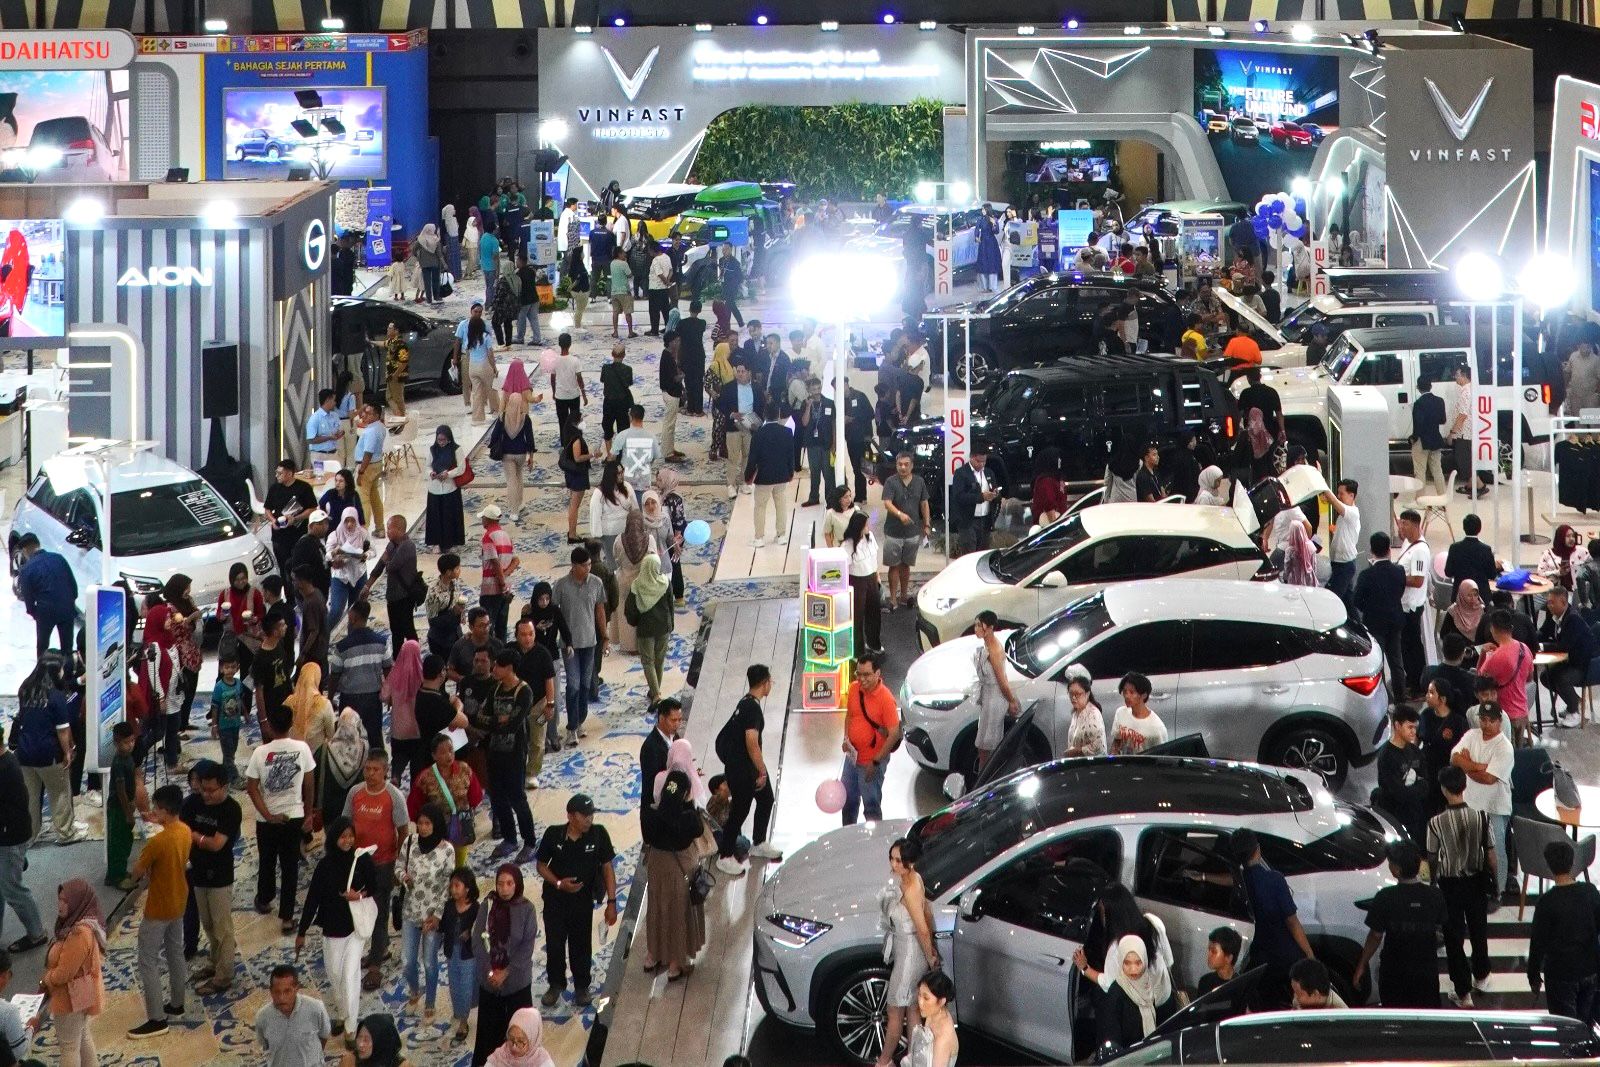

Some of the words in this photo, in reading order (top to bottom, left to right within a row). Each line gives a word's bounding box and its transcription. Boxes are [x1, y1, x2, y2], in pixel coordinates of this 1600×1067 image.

[1, 41, 110, 60] DAIHATSU
[233, 61, 274, 71] BAHAGIA
[304, 60, 347, 71] PERTAMA
[1254, 65, 1293, 75] VINFAST
[1244, 87, 1295, 104] FUTURE
[578, 108, 685, 122] VINFAST
[1409, 148, 1512, 162] VINFAST
[116, 266, 213, 287] AION
[1478, 395, 1492, 461] BAIC
[817, 682, 825, 692] 6
